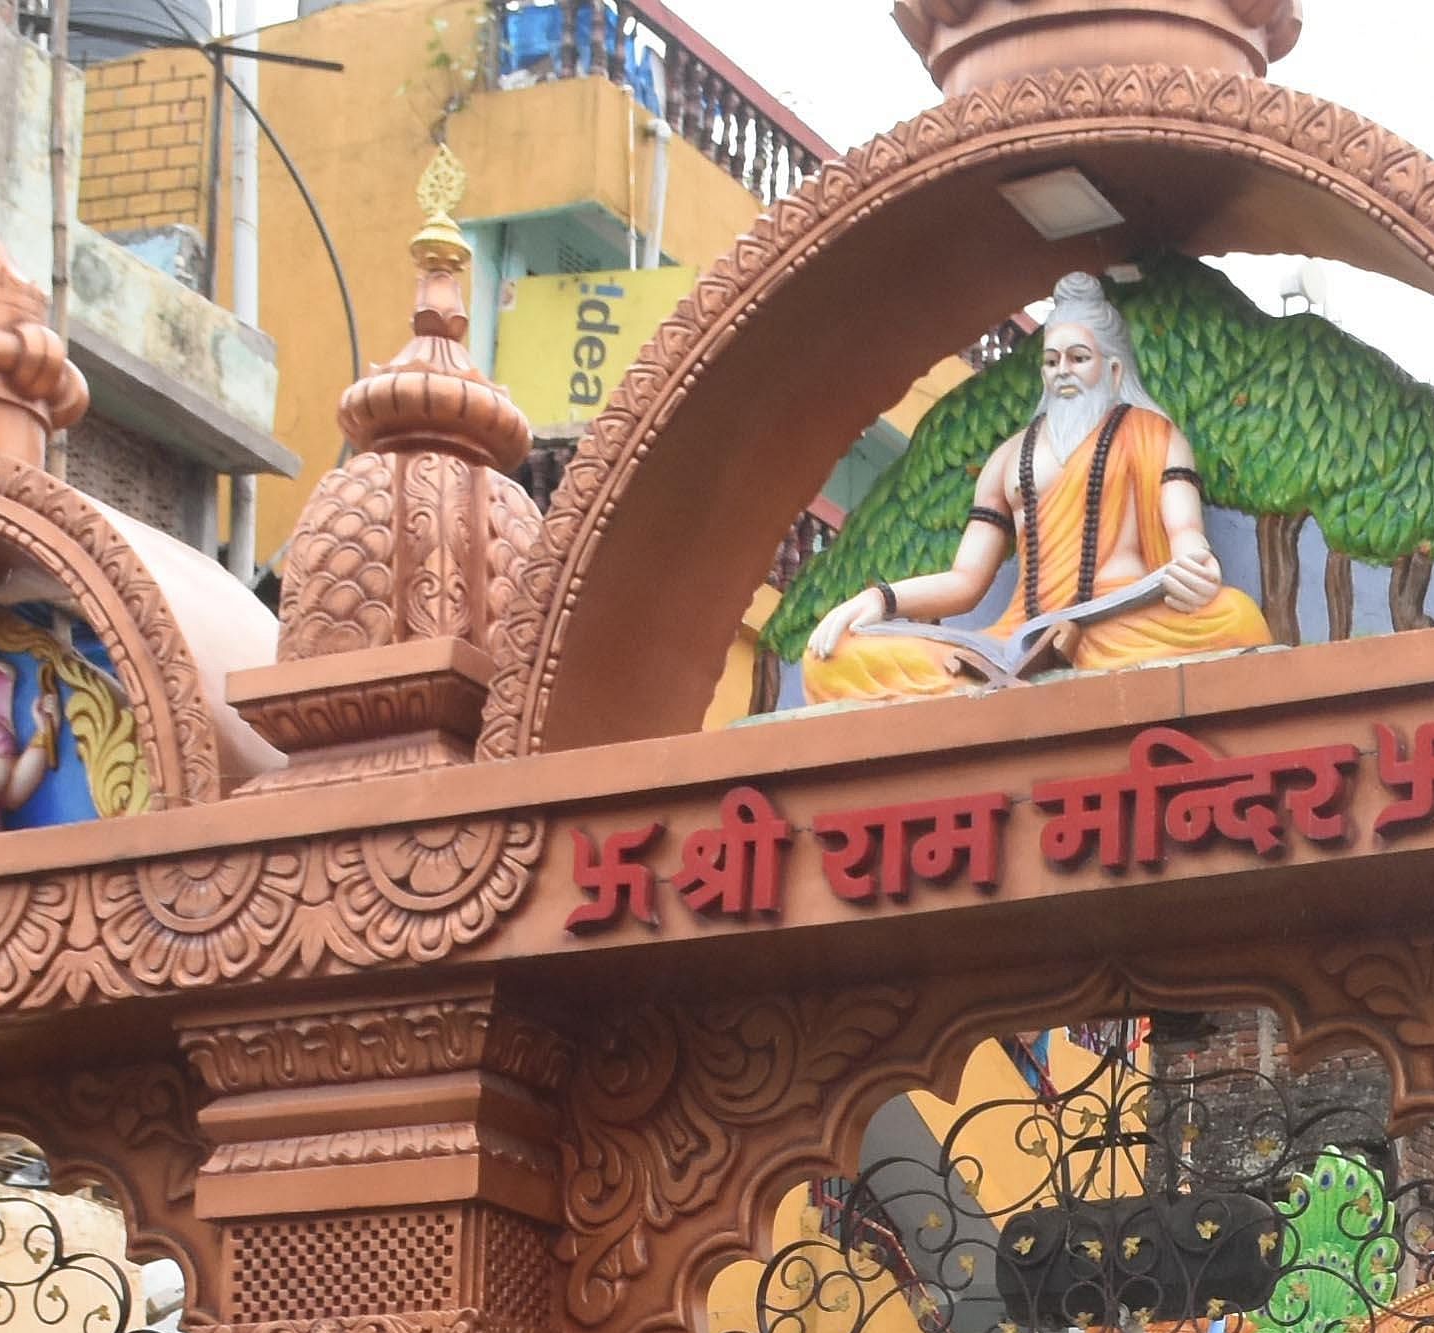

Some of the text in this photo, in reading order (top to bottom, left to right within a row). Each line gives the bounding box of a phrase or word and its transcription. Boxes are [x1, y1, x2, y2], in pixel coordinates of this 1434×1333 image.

[671, 727, 1361, 915] श्री राम मन्दिर
